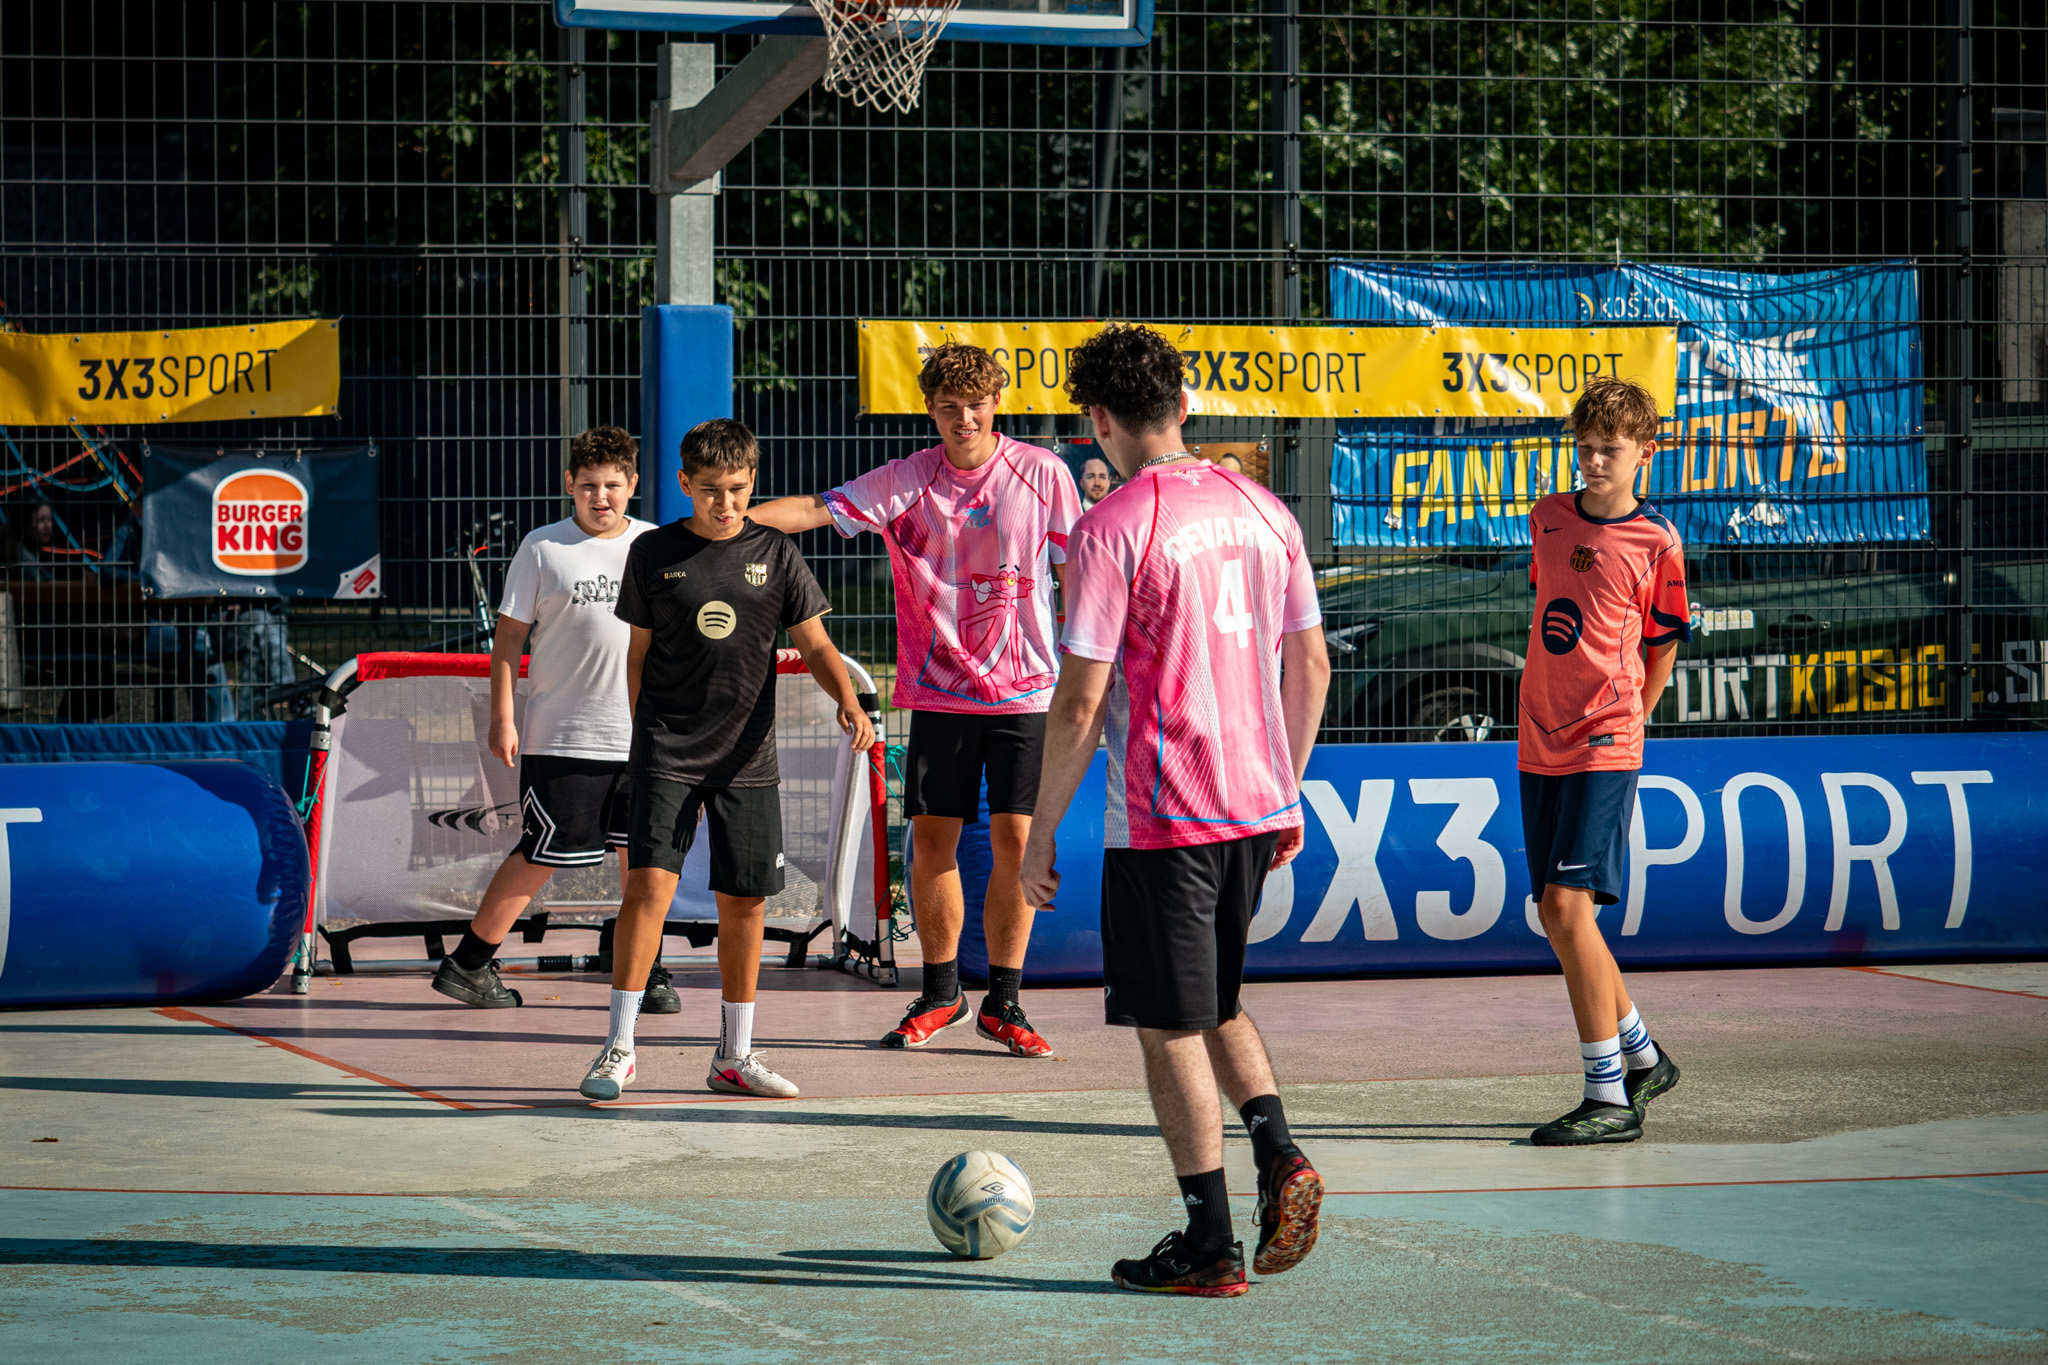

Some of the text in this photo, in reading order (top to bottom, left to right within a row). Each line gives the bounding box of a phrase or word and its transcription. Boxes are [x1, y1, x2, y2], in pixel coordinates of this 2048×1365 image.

[1599, 291, 1680, 319] KOŠICE
[78, 349, 278, 401] 3X3SPORT
[1184, 350, 1366, 393] 3X3SPORT
[218, 504, 303, 523] BURGER
[218, 525, 303, 552] KING
[664, 571, 687, 580] BARÇA
[1213, 558, 1253, 649] 4
[1247, 770, 1994, 944] X3PORT
